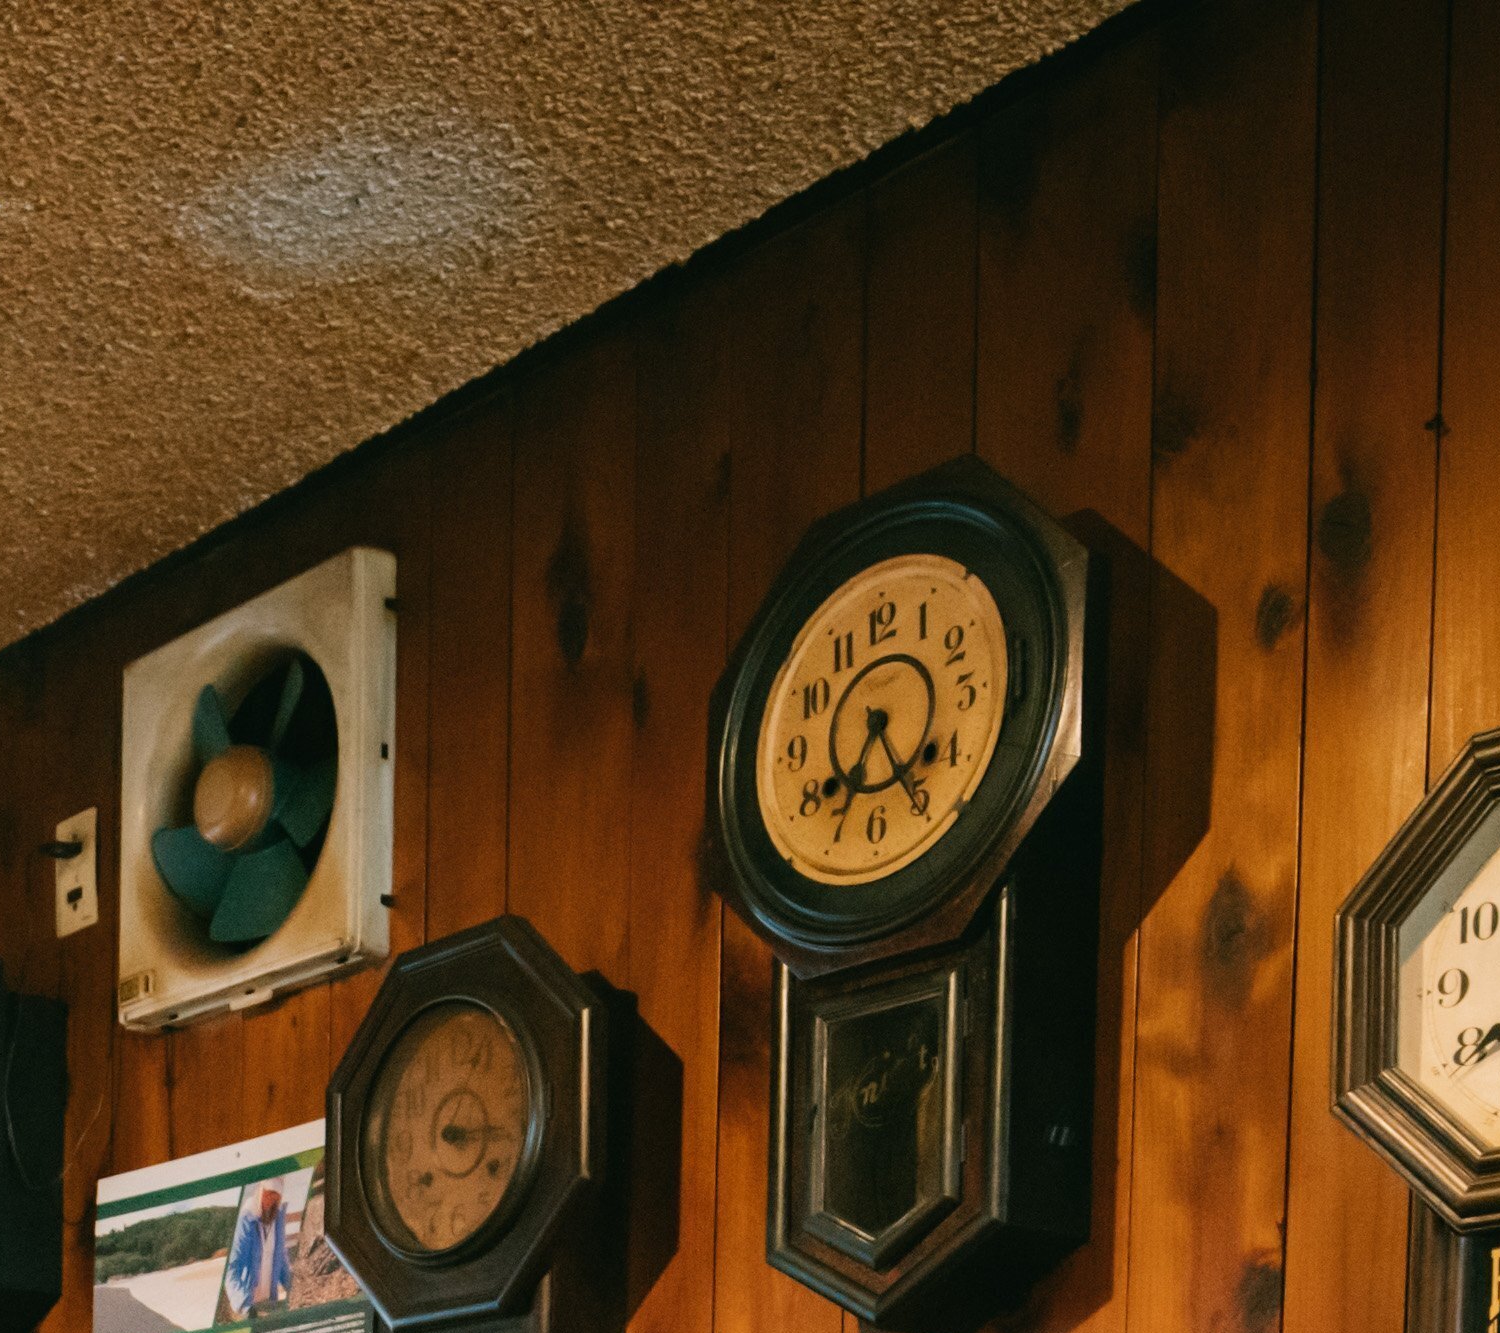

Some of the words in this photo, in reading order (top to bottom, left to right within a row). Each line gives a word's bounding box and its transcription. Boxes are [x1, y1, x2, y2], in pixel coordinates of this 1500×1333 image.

[868, 601, 897, 646] 12
[918, 601, 928, 641] 1
[833, 631, 854, 673] 11
[944, 625, 965, 667] 2
[802, 677, 830, 720] 10
[957, 672, 977, 711] 3
[787, 735, 808, 771] 9
[938, 731, 961, 768] 4
[800, 780, 820, 817] 8
[866, 805, 887, 844] 6
[1459, 901, 1499, 944] 10
[1437, 968, 1470, 1008] 9
